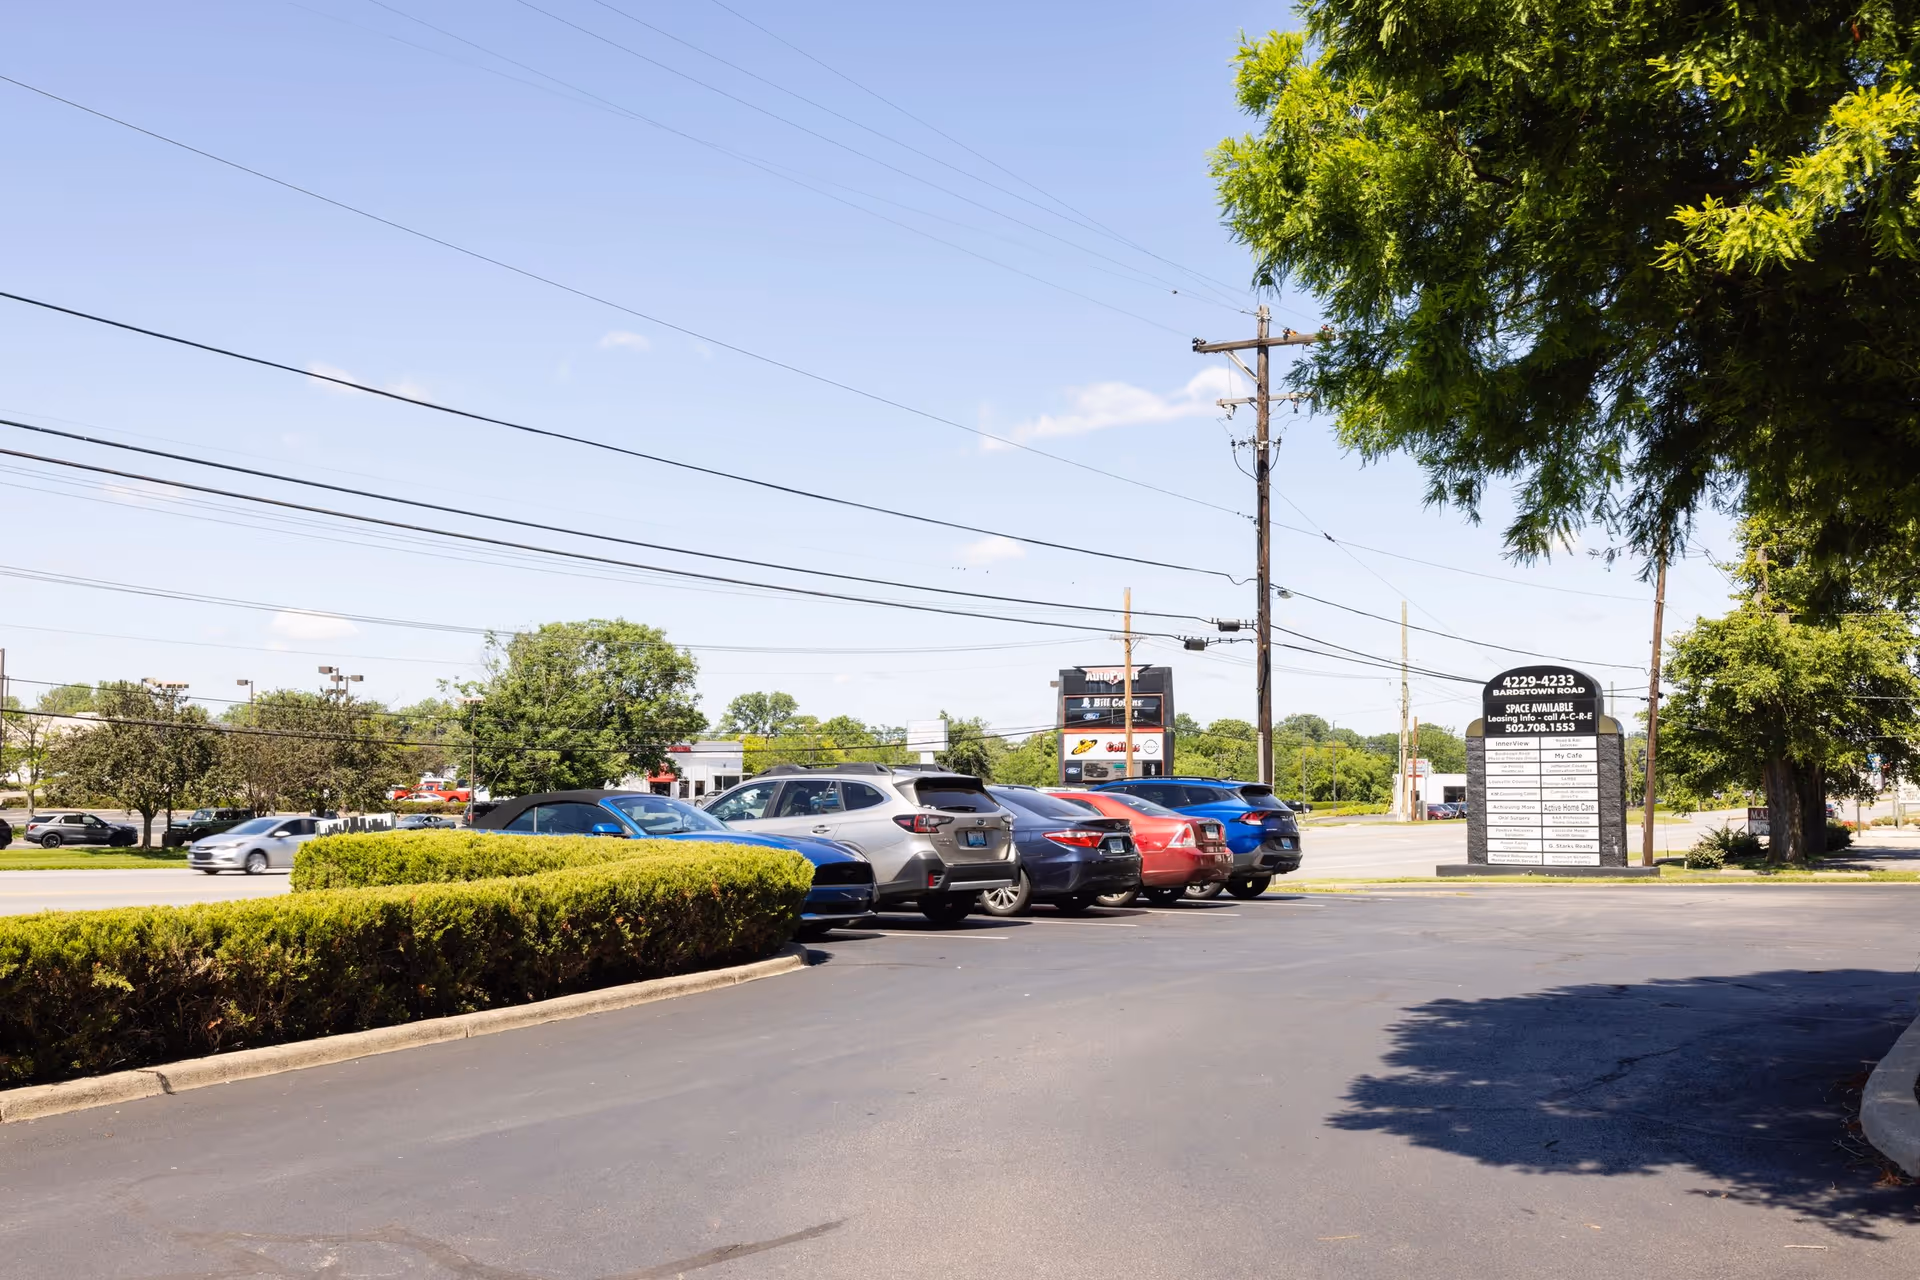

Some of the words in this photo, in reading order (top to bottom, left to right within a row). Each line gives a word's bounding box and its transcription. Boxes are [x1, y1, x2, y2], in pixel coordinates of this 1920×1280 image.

[1085, 671, 1139, 681] AutoPont
[1503, 675, 1575, 688] 4229-4233
[1493, 688, 1555, 696] BARDSTOWN
[1093, 698, 1110, 707] Bill
[1112, 698, 1142, 707] Colns
[1506, 704, 1530, 714] SPACE
[1532, 702, 1574, 713] AVAILABLE
[1488, 715, 1517, 723] Leasing
[1520, 714, 1535, 722] Info
[1544, 713, 1558, 721] call
[1559, 712, 1592, 720] A-C-R-E
[1505, 723, 1575, 733] 502.708.1553
[1106, 741, 1140, 752] Collns
[1544, 803, 1561, 811] Active
[1562, 803, 1579, 811] Home
[1580, 802, 1594, 811] Care
[1750, 810, 1769, 819] M.A.
